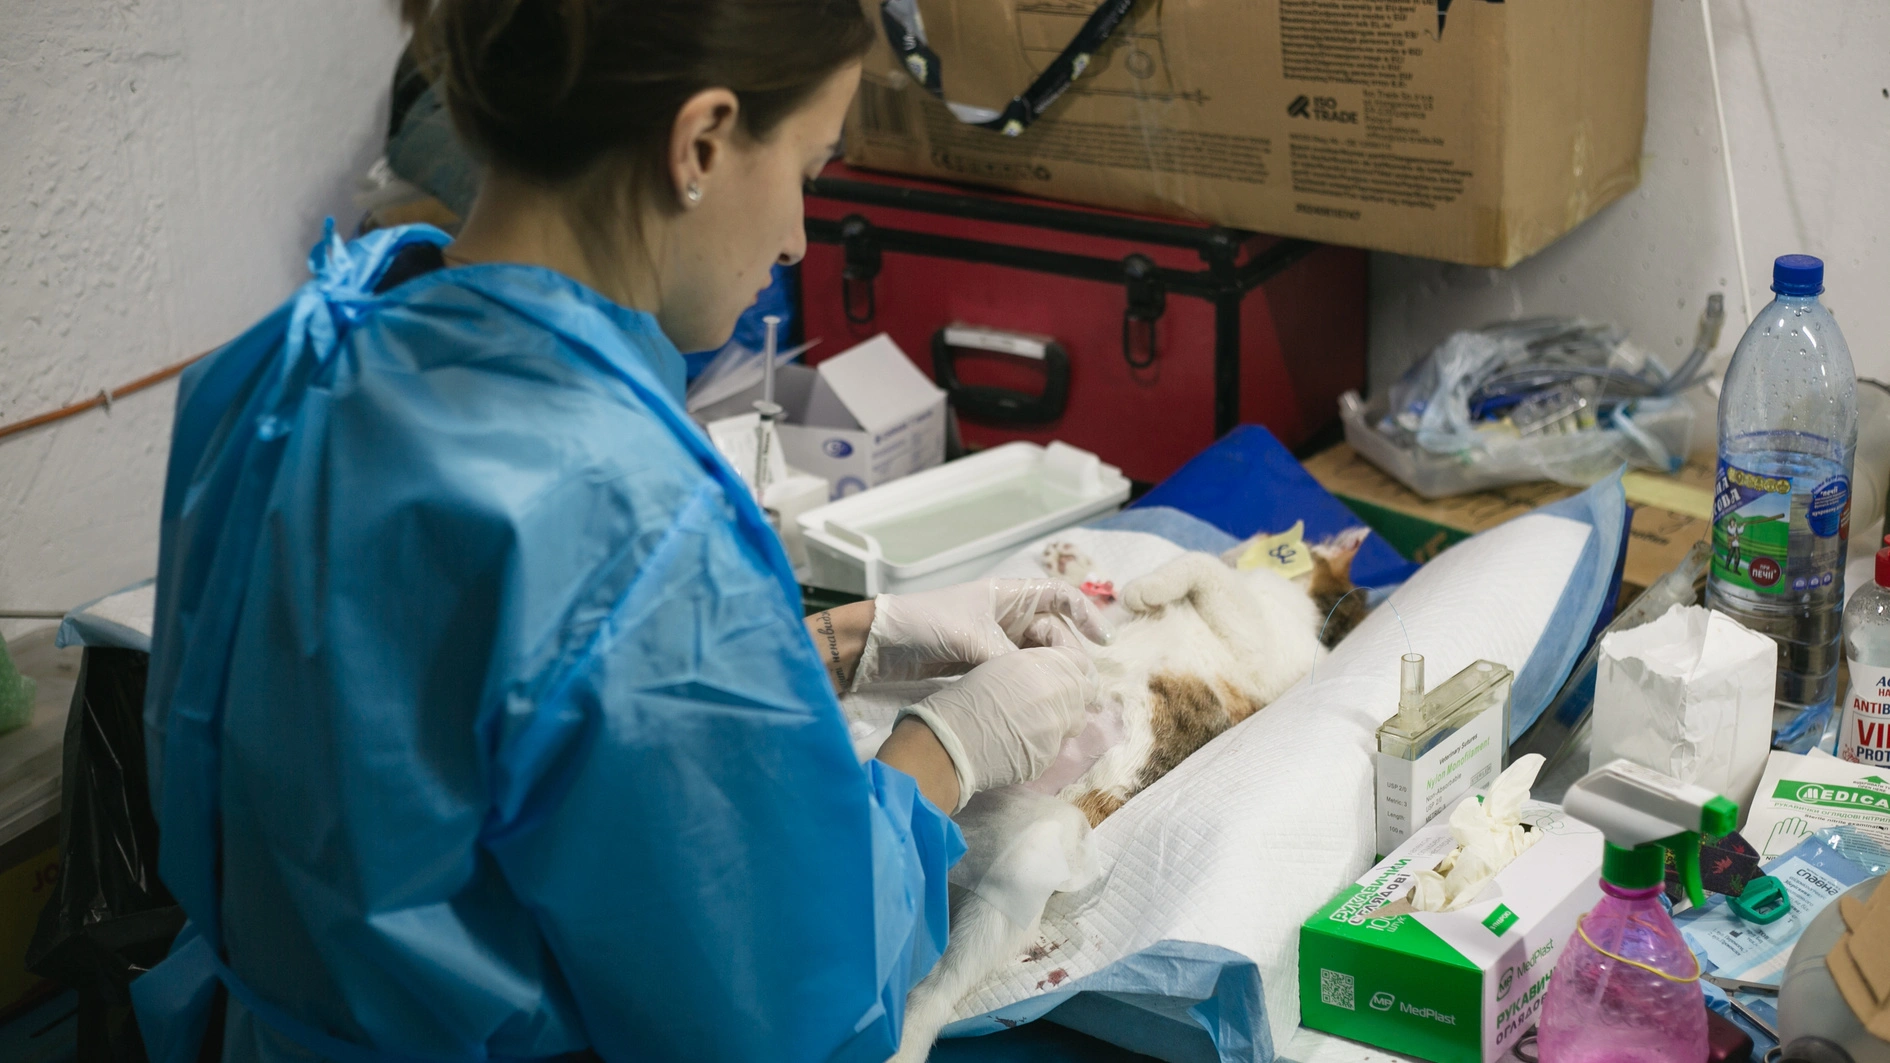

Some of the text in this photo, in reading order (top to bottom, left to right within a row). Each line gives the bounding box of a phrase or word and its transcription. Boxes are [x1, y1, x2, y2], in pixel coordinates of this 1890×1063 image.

[1312, 96, 1337, 110] ISO
[1313, 109, 1359, 125] TRADE
[1438, 734, 1478, 765] Veterinary Sutures
[1426, 770, 1445, 790] Nylon
[1446, 737, 1490, 776] Monofilament
[1426, 773, 1462, 803] Non-Absorbable
[1386, 796, 1403, 806] Metric:
[1387, 811, 1405, 820] Length:
[1389, 825, 1399, 834] 100
[1330, 858, 1412, 923] РУКАВИЧКИ
[1516, 938, 1554, 979] MedPlast
[1400, 1002, 1456, 1025] MedPlast
